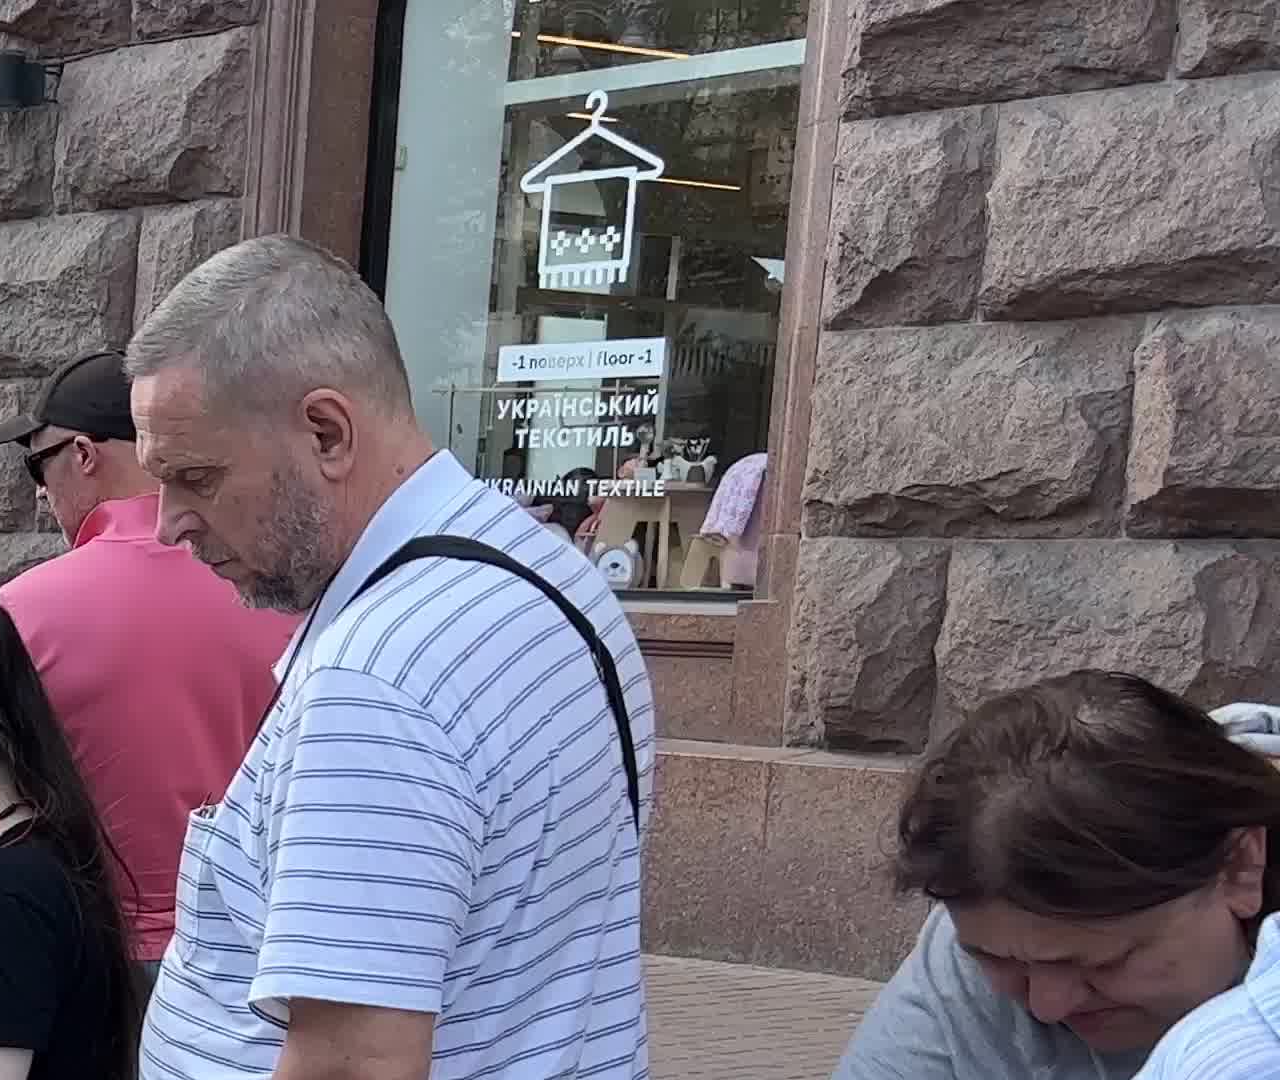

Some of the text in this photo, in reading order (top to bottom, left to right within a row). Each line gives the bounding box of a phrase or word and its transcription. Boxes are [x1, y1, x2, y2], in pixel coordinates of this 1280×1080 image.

[596, 351, 635, 368] floor
[496, 388, 660, 420] УКРАЇНСЬКИЙ
[515, 424, 635, 450] ТЕКСТИЛЬ
[585, 479, 666, 498] TEXTILE
